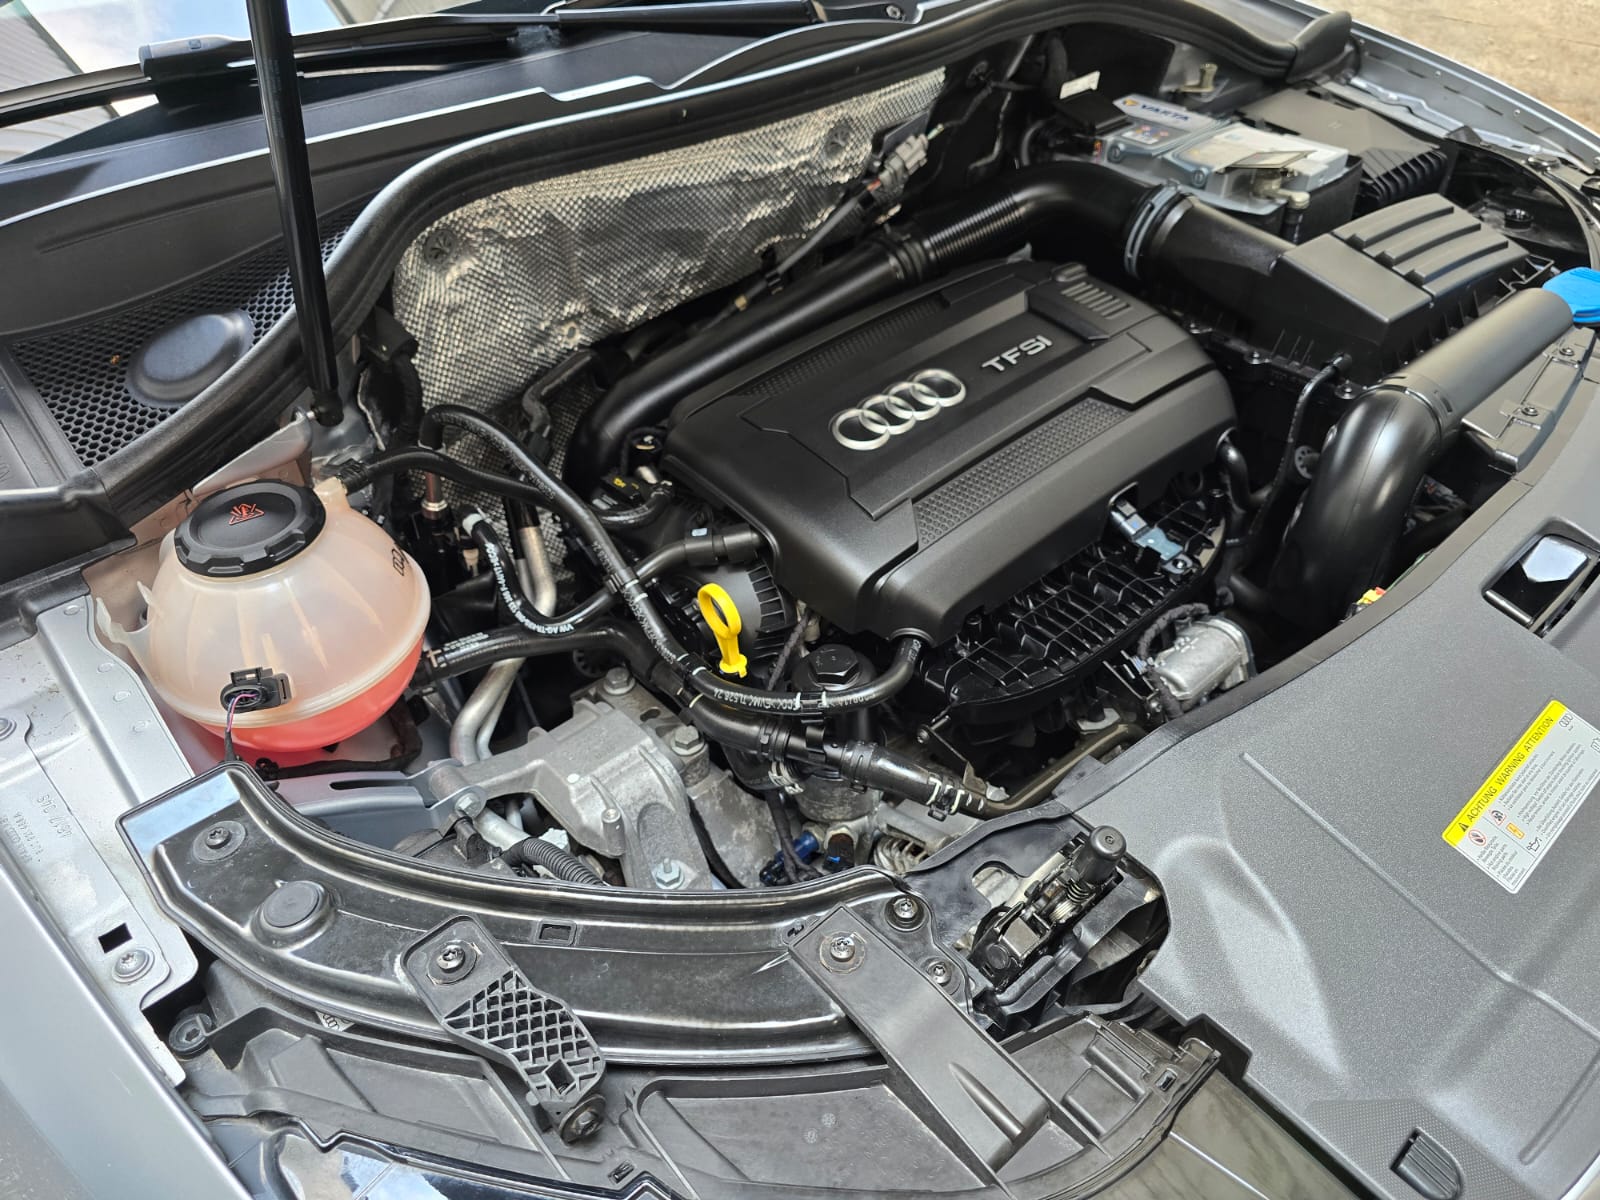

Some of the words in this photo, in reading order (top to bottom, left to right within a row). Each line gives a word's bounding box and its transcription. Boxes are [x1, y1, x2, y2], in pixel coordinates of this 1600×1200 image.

[1141, 103, 1190, 121] VARTA
[982, 335, 1052, 371] TFSI
[1467, 786, 1498, 823] ACHTUNG
[1496, 752, 1525, 786] WARNING
[1524, 716, 1554, 753] ATTENTION
